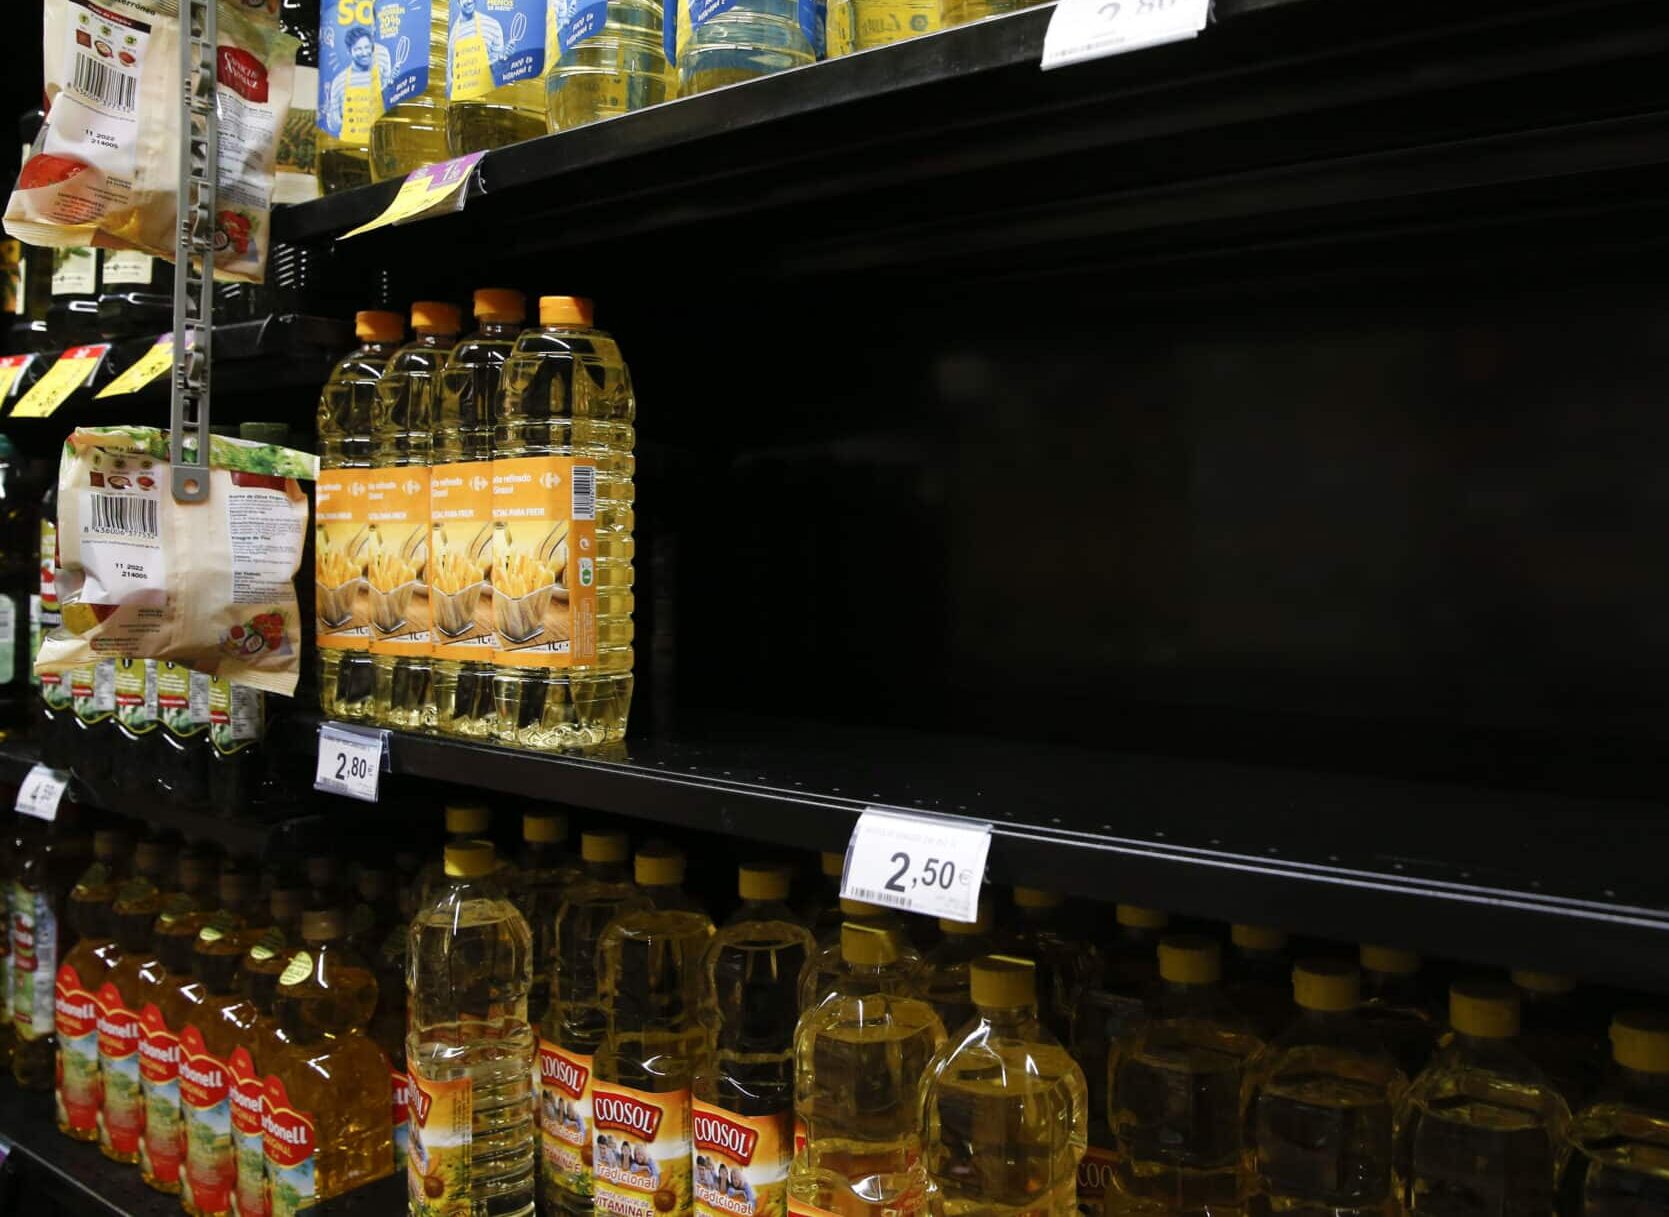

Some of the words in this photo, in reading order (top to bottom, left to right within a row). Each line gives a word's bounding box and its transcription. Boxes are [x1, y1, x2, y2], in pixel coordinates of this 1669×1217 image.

[127, 564, 143, 572] 2022
[336, 753, 367, 780] 2,80
[884, 852, 955, 893] 2,50
[594, 1097, 654, 1134] COOSOL
[694, 1117, 748, 1157] COOSOL
[598, 1162, 657, 1189] Tradicional
[696, 1184, 753, 1215] Tradicional
